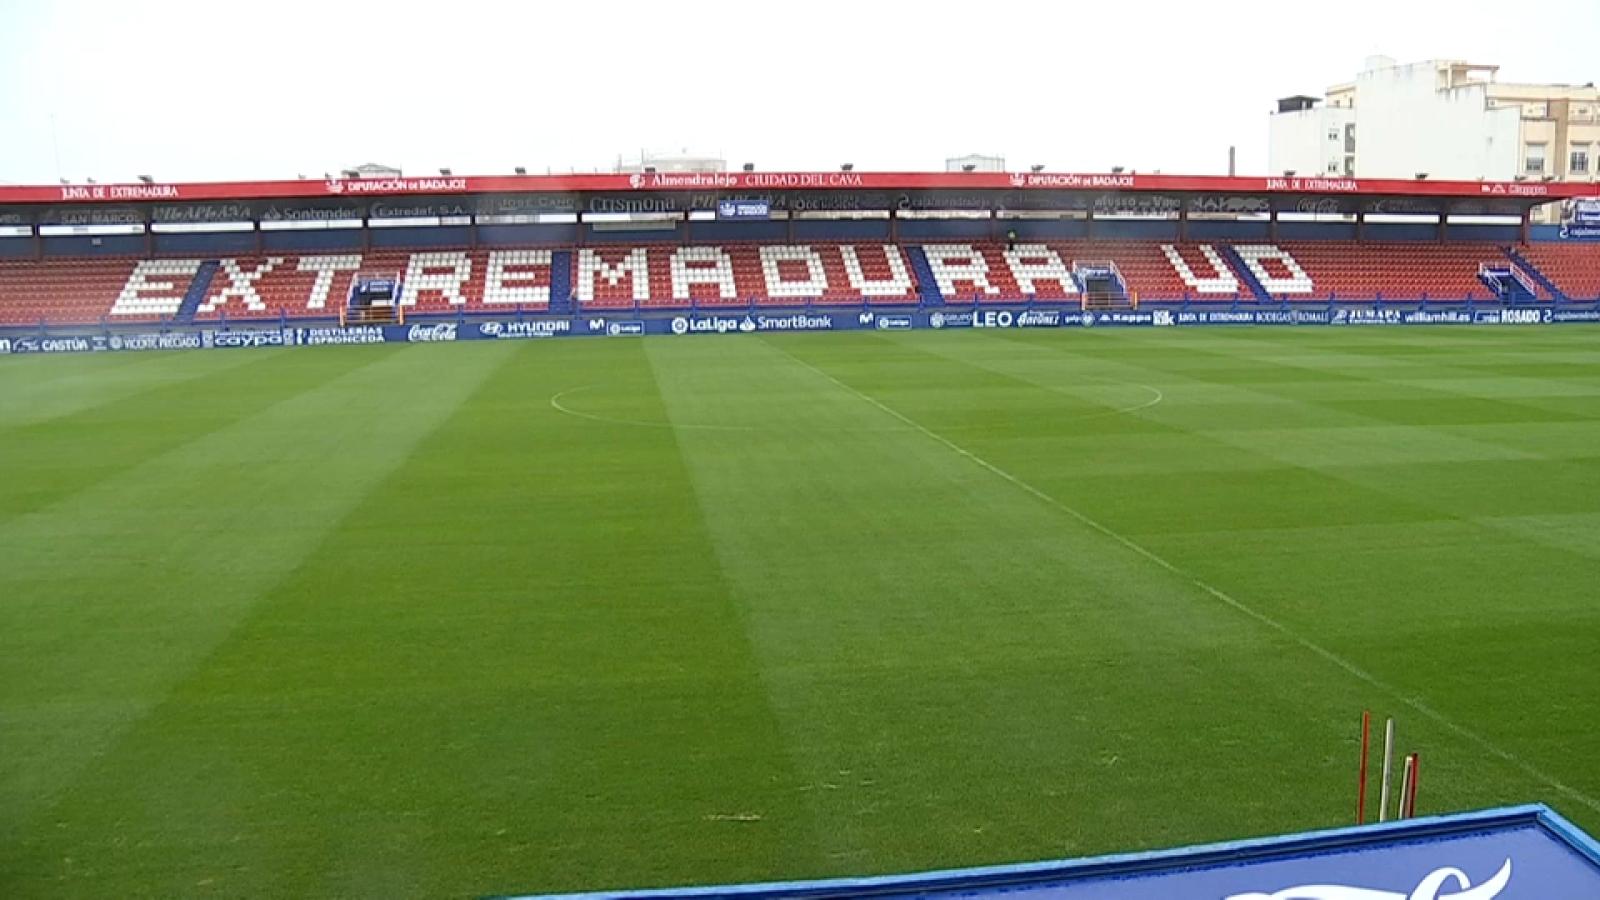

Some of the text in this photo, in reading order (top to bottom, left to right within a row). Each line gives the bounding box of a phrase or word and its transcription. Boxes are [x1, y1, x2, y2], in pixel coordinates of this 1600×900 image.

[347, 178, 407, 192] DIPUTACIÓN
[419, 178, 466, 190] BADAJOZ
[652, 173, 863, 188] Almendralejo CIUDAD DEL CAVA
[1027, 173, 1082, 186] DIPUTACIÓN
[1093, 176, 1134, 186] BADAJOZ
[62, 185, 179, 200] JUNTA DE EXTREMADURA
[284, 206, 357, 220] Santander
[109, 243, 1078, 315] EXTREMADURA
[690, 314, 833, 333] LaLiga SmartBank
[973, 311, 1013, 328] LEO
[1501, 309, 1541, 324] ROSADO
[507, 319, 570, 333] HYUNDAI
[41, 335, 89, 351] CASTÚA
